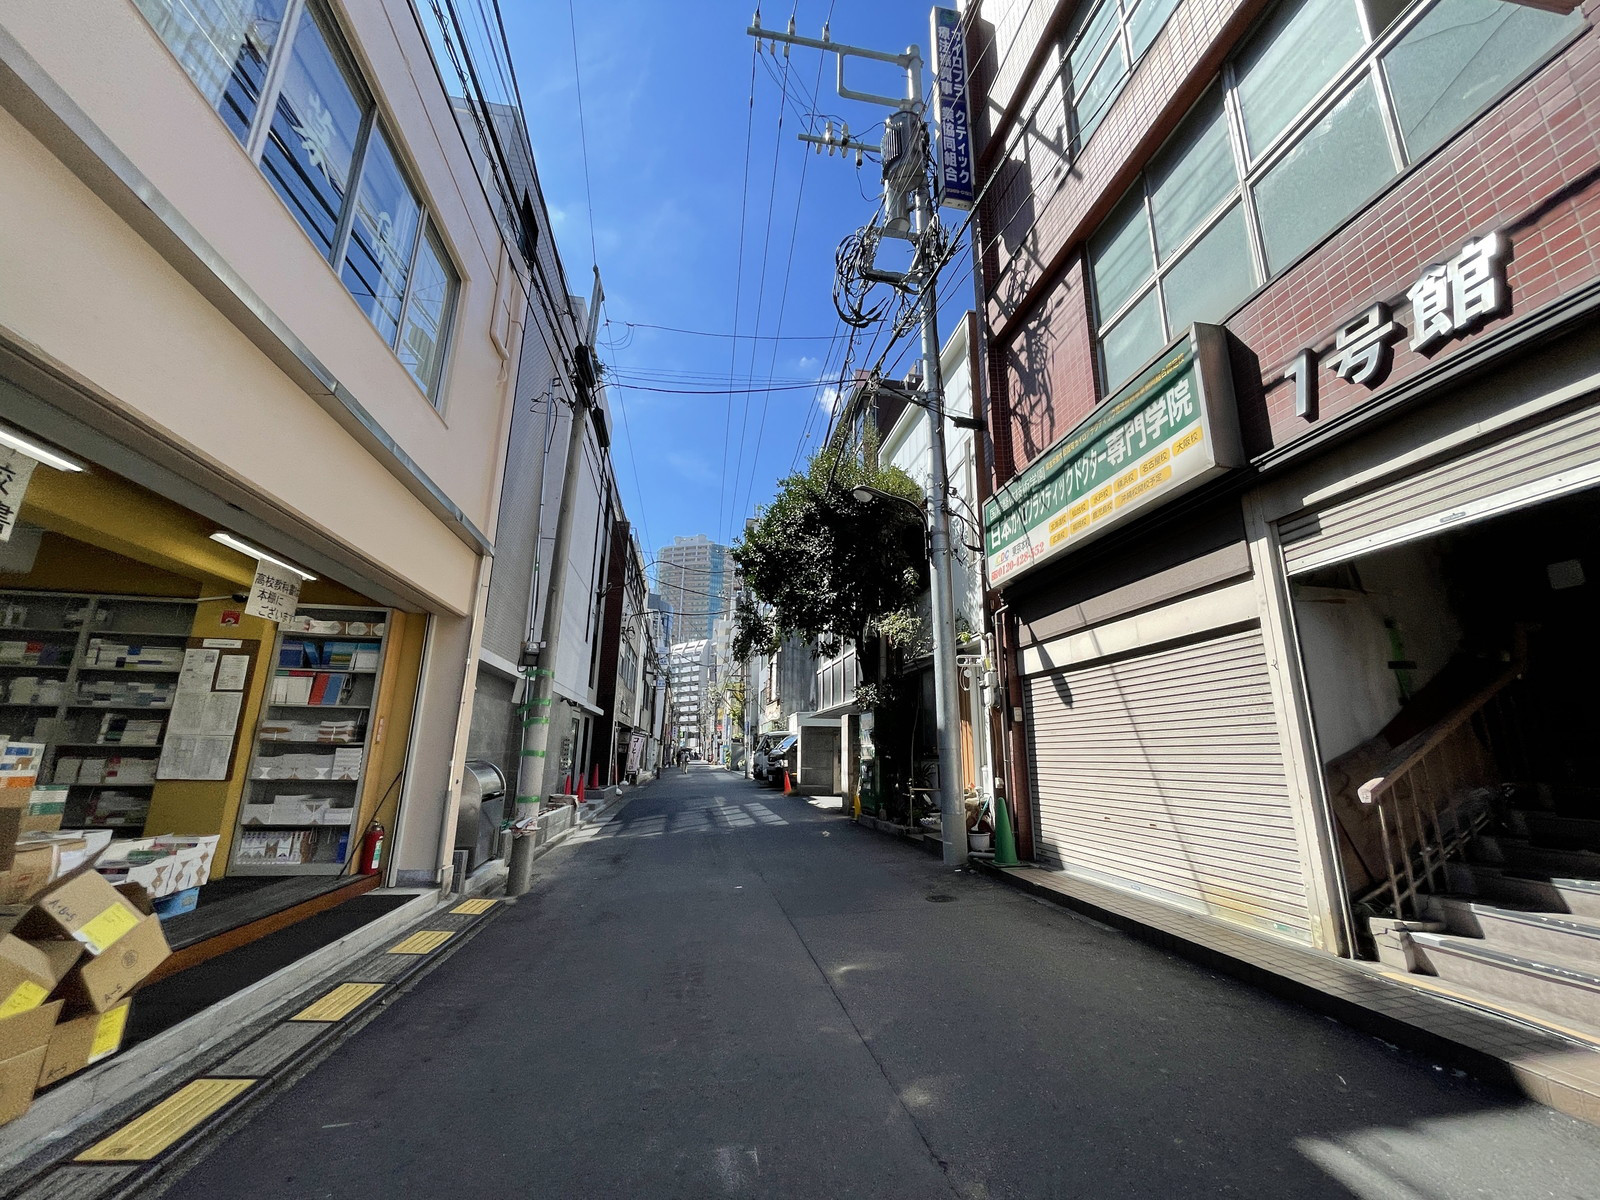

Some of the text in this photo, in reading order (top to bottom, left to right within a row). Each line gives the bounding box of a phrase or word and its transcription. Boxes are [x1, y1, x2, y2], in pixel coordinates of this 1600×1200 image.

[1142, 451, 1168, 473] 名古屋校
[1176, 431, 1199, 453] 大阪校
